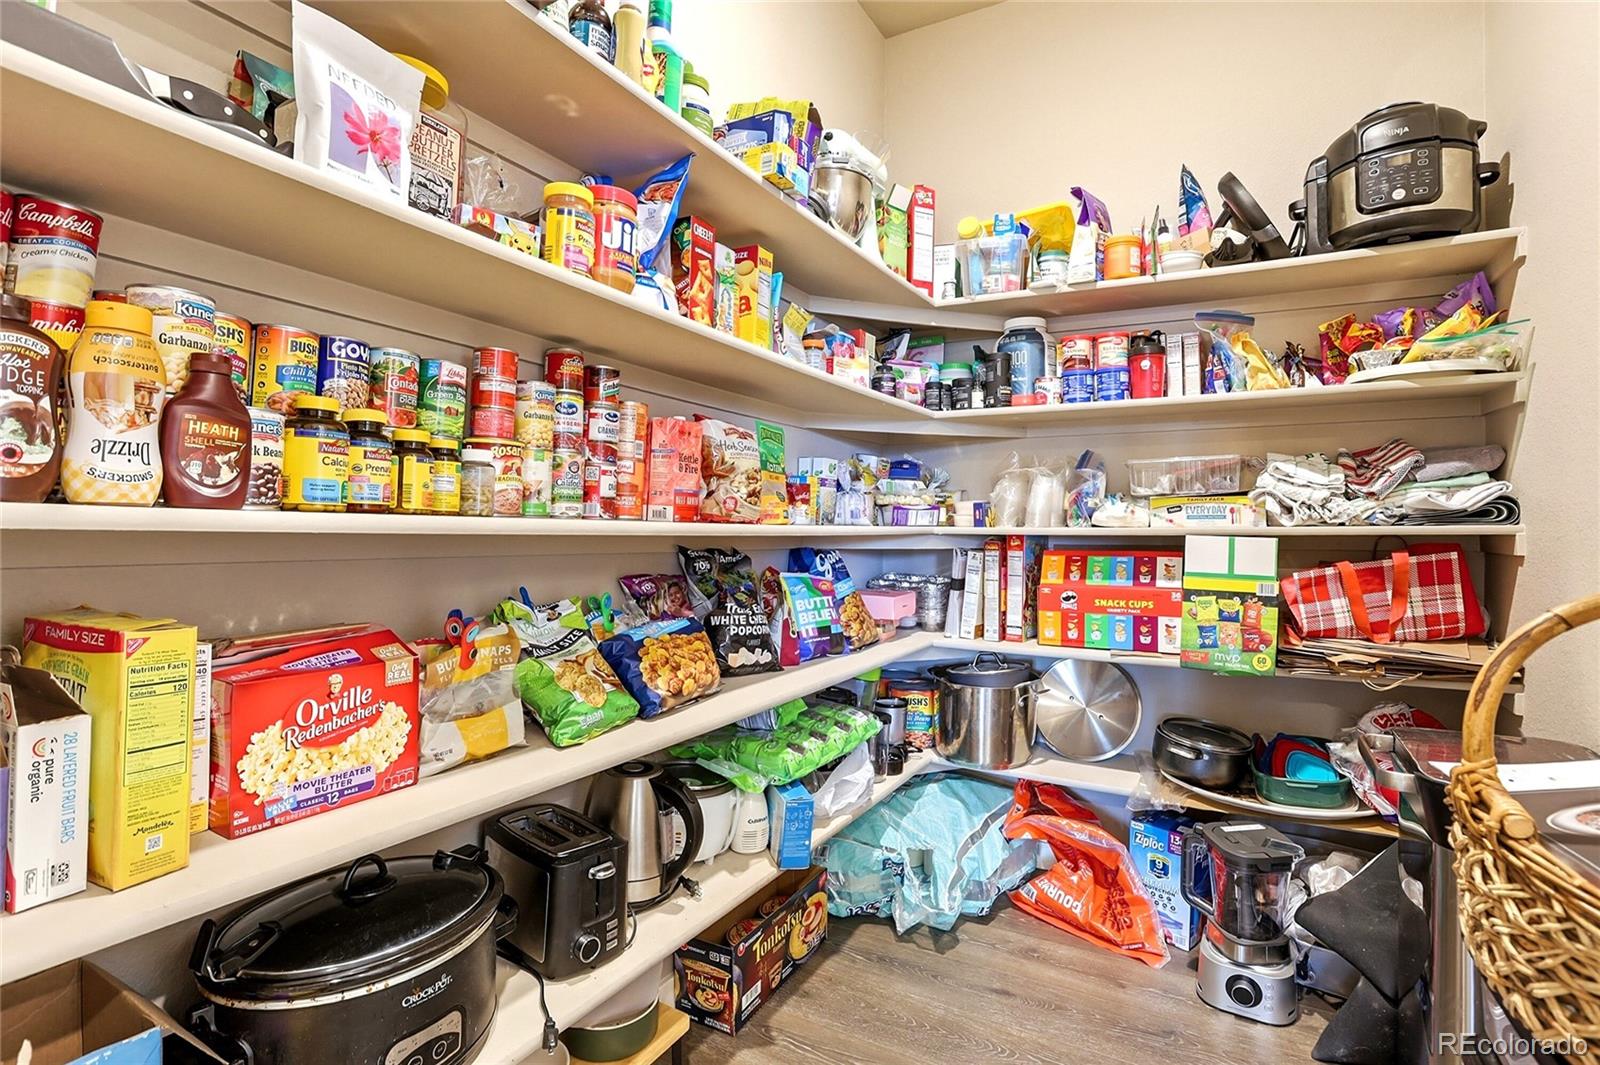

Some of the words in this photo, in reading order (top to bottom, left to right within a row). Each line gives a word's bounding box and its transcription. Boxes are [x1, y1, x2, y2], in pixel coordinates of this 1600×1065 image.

[327, 62, 397, 110] NEEDED
[1383, 126, 1410, 137] NINJA
[412, 132, 453, 160] BUTTER
[408, 141, 456, 171] PRETZELS
[18, 202, 94, 238] Campbell's
[52, 238, 87, 250] COOKING
[21, 249, 50, 259] Cream
[59, 248, 89, 263] Chicken
[159, 332, 207, 352] Garbanzo
[1, 353, 31, 368] Hot
[93, 355, 159, 373] Butterscotch
[282, 366, 306, 379] Chili
[427, 390, 454, 400] Green
[188, 420, 239, 441] HEATH
[184, 436, 215, 447] SHELL
[91, 438, 151, 466] Drizzle
[87, 467, 154, 483] SMUCKER'S
[684, 463, 699, 474] Fire
[1185, 505, 1227, 515] EVERYDAY
[1094, 599, 1127, 607] SNACK
[1128, 600, 1154, 609] CUPS
[710, 615, 746, 626] WHITE
[45, 626, 80, 641] FAMILY
[81, 631, 106, 646] SIZE
[560, 630, 584, 648] SIZE
[1215, 652, 1240, 664] mvp
[131, 665, 166, 675] Nutrition
[168, 662, 188, 673] Facts
[388, 671, 412, 681] REAL
[129, 690, 156, 698] Calories
[173, 683, 188, 692] 120
[296, 685, 372, 727] Orville
[282, 699, 386, 750] Redenbacher's
[63, 731, 78, 745] 28
[43, 758, 55, 785] pure
[62, 748, 77, 787] LAYERED
[28, 760, 43, 803] organic
[293, 777, 326, 792] MOVIE
[331, 766, 372, 784] THEATER
[315, 779, 353, 794] BUTTER
[61, 788, 76, 817] FRUIT
[300, 797, 324, 807] CLASSIC
[326, 792, 339, 804] 12
[60, 818, 75, 844] BARS
[1135, 833, 1165, 850] Ziploc
[1155, 859, 1163, 869] 9
[753, 909, 803, 963] Tonkotsu
[685, 969, 724, 991] Tonkotsu
[401, 973, 453, 1008] CROCK-POT
